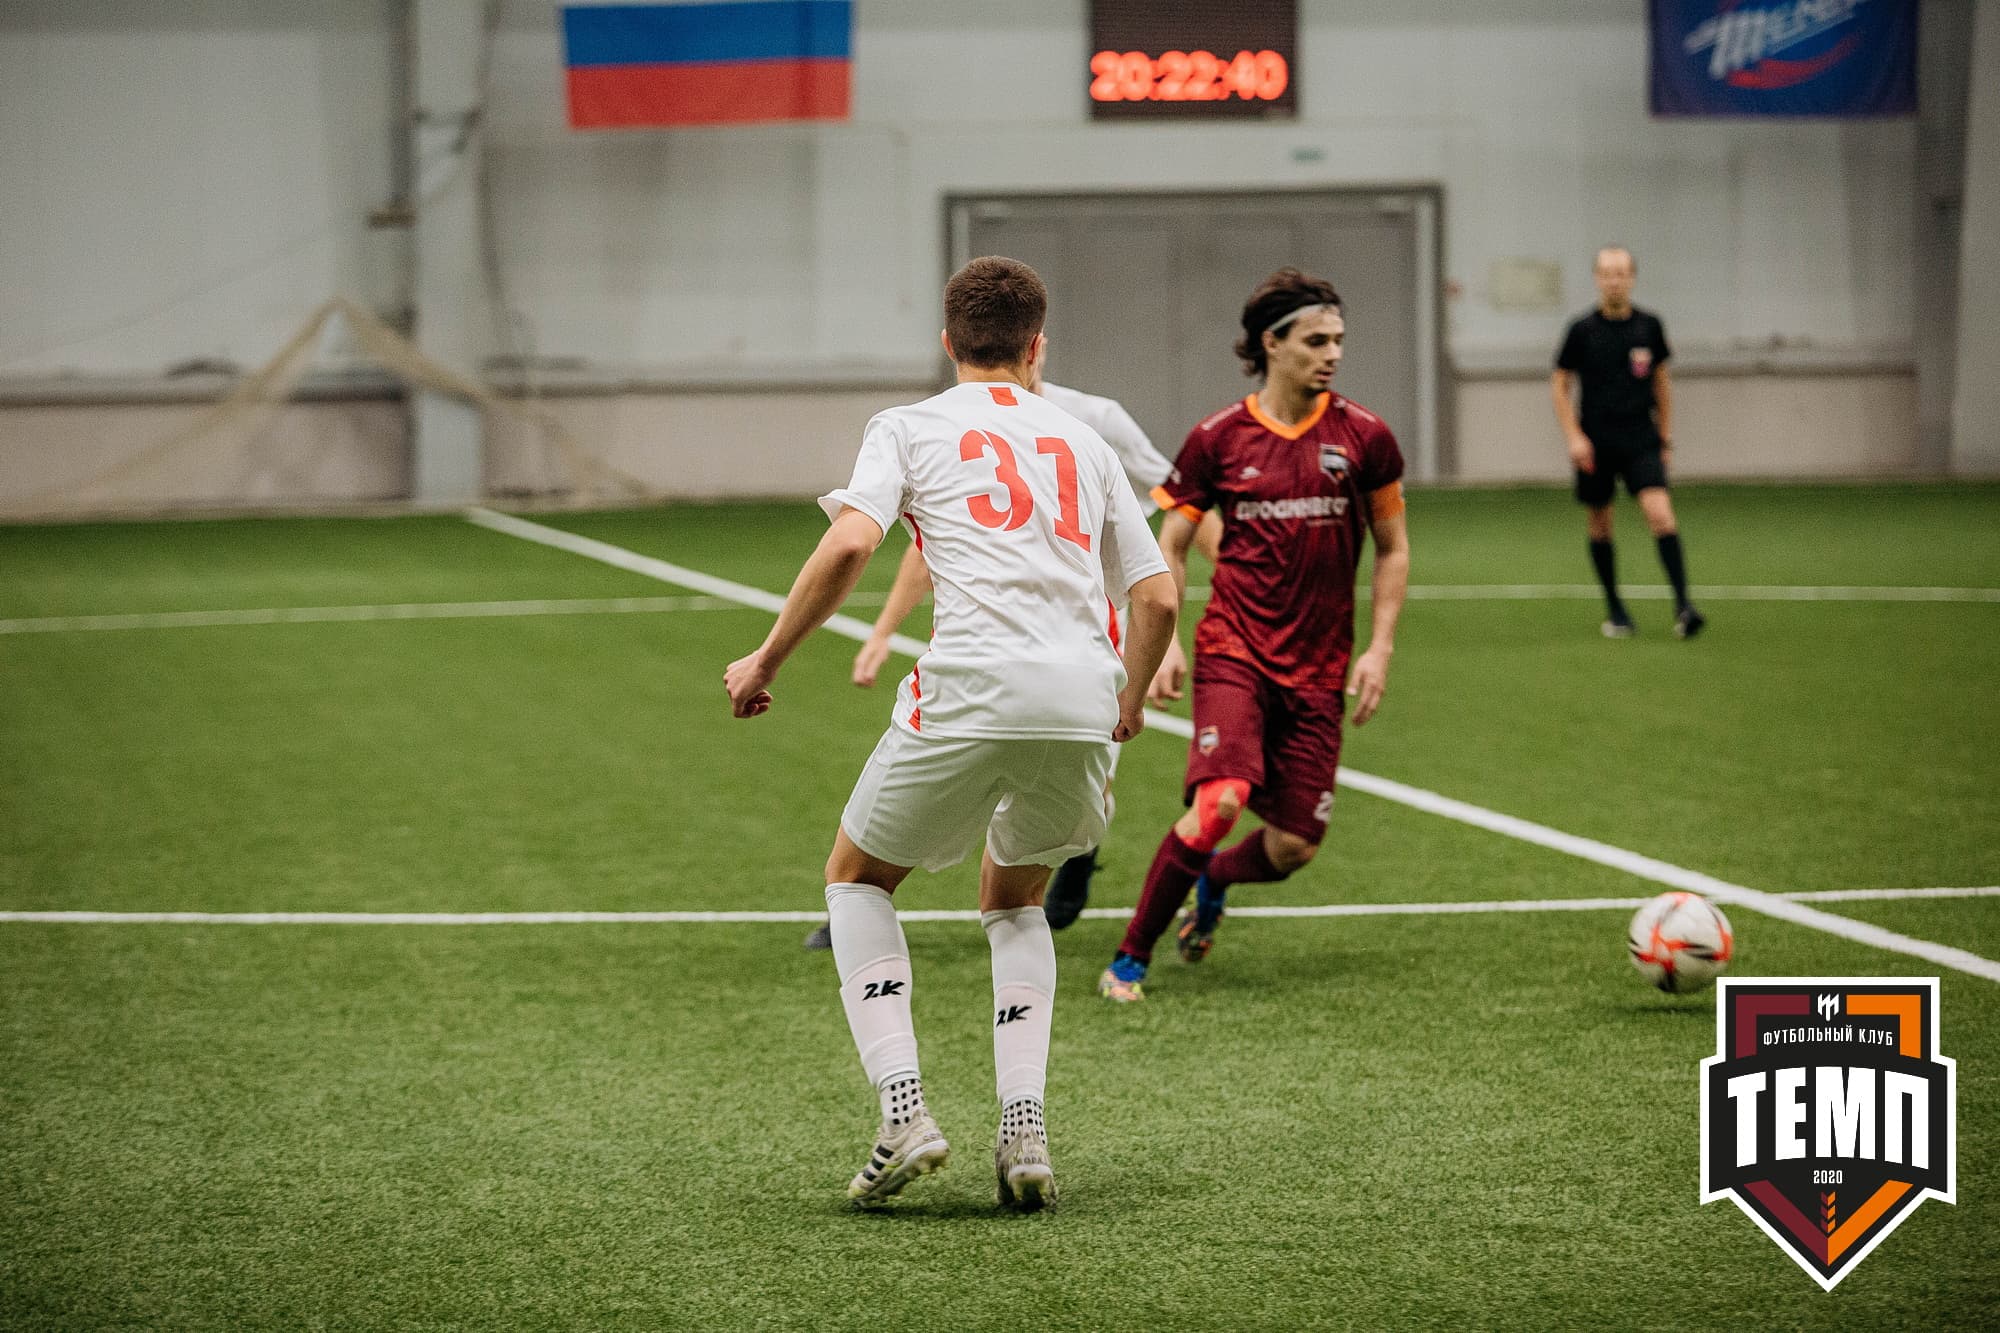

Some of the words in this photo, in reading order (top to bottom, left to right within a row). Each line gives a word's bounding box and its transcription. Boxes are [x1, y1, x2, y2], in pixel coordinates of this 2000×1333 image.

[1090, 50, 1288, 101] 20:22:40
[959, 429, 1091, 553] 31
[862, 980, 905, 1001] 2K
[996, 1005, 1032, 1027] 2K
